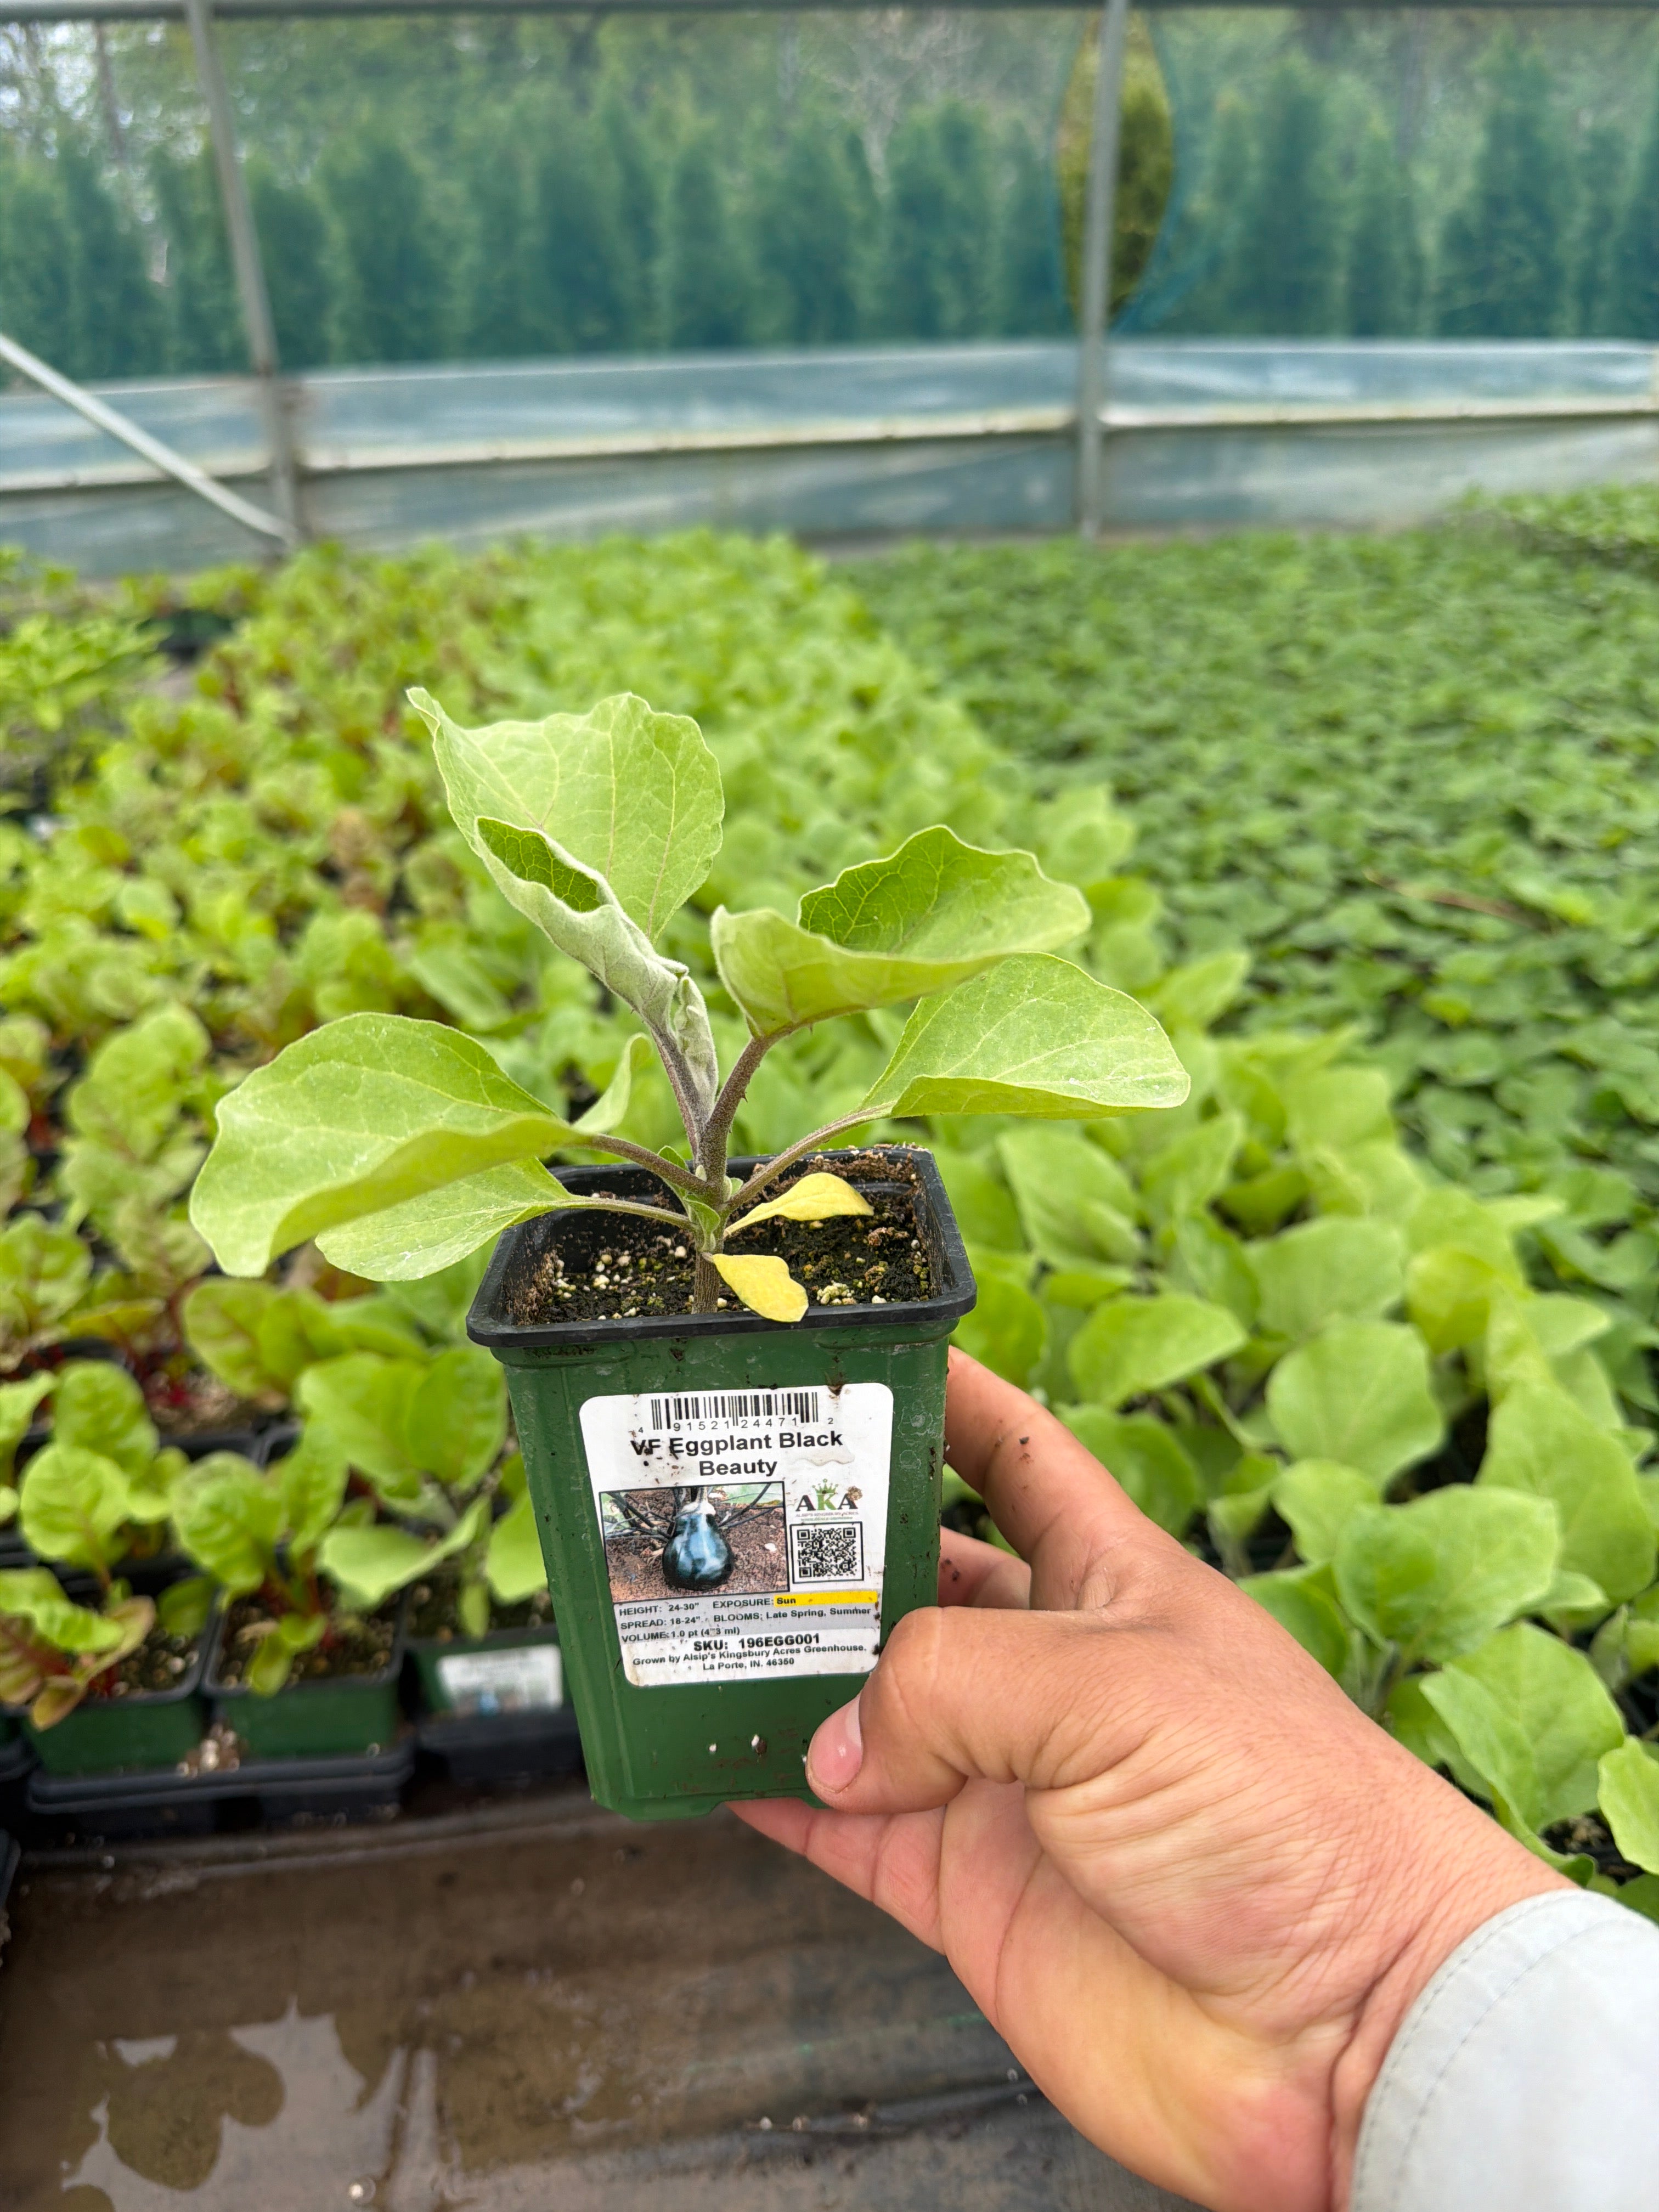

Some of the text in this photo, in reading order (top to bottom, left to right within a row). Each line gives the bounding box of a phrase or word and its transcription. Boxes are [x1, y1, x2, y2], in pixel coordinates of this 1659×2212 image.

[673, 1420, 730, 1431] 91521
[741, 1418, 797, 1429] 24471
[630, 1430, 843, 1457] VF Eggplant Black
[699, 1458, 778, 1477] Beauty
[795, 1492, 859, 1512] AKA
[619, 1605, 662, 1616] HEIGHT:
[713, 1598, 774, 1609] EXPOSURE:
[620, 1618, 667, 1629] SPREAD:
[621, 1626, 740, 1643] VOLUME: 1.0 pt (43 ml)
[693, 1633, 820, 1651] SKU: 196EGG001
[633, 1657, 665, 1666] Grown
[669, 1654, 680, 1663] by
[683, 1651, 716, 1661] Alsip's
[719, 1649, 770, 1659] Kingsbury
[773, 1647, 801, 1655] Acres
[703, 1662, 715, 1671] La
[718, 1661, 747, 1670] Porte,
[766, 1657, 794, 1666] 46350
